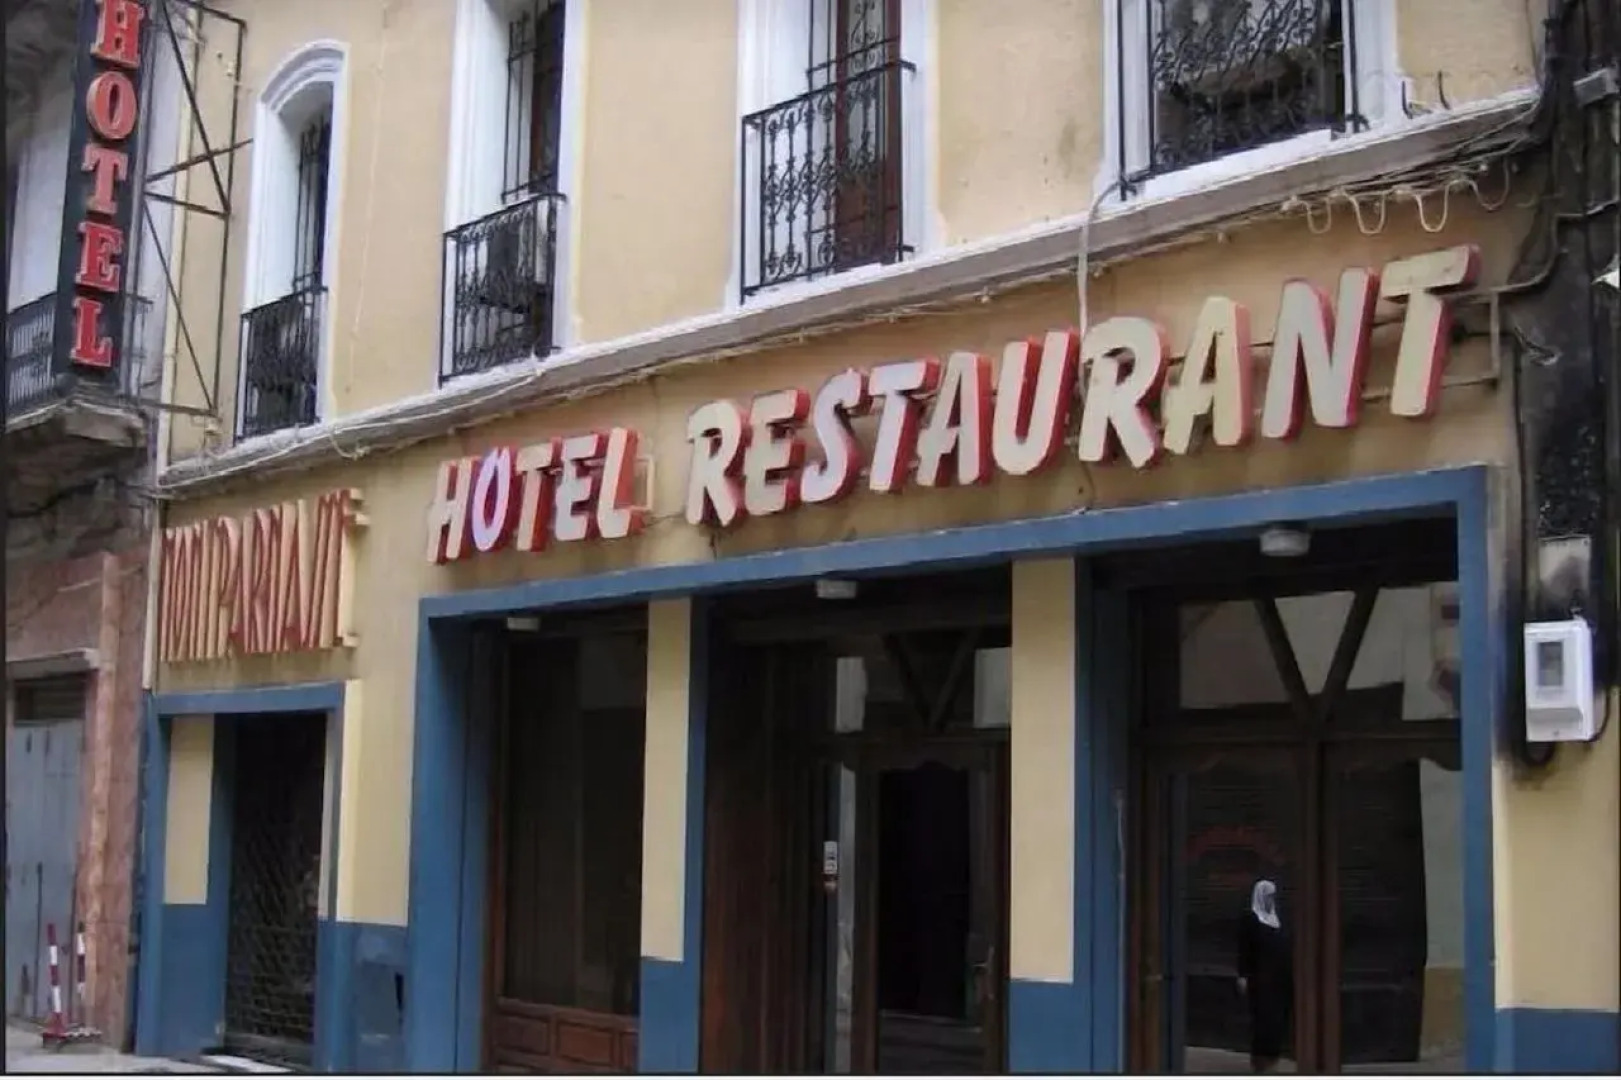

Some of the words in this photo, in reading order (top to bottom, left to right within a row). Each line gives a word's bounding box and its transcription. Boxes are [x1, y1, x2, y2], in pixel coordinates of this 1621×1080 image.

[71, 0, 145, 368] HOTEL
[426, 426, 640, 564] HOTEL
[685, 244, 1479, 527] RESTAURANT
